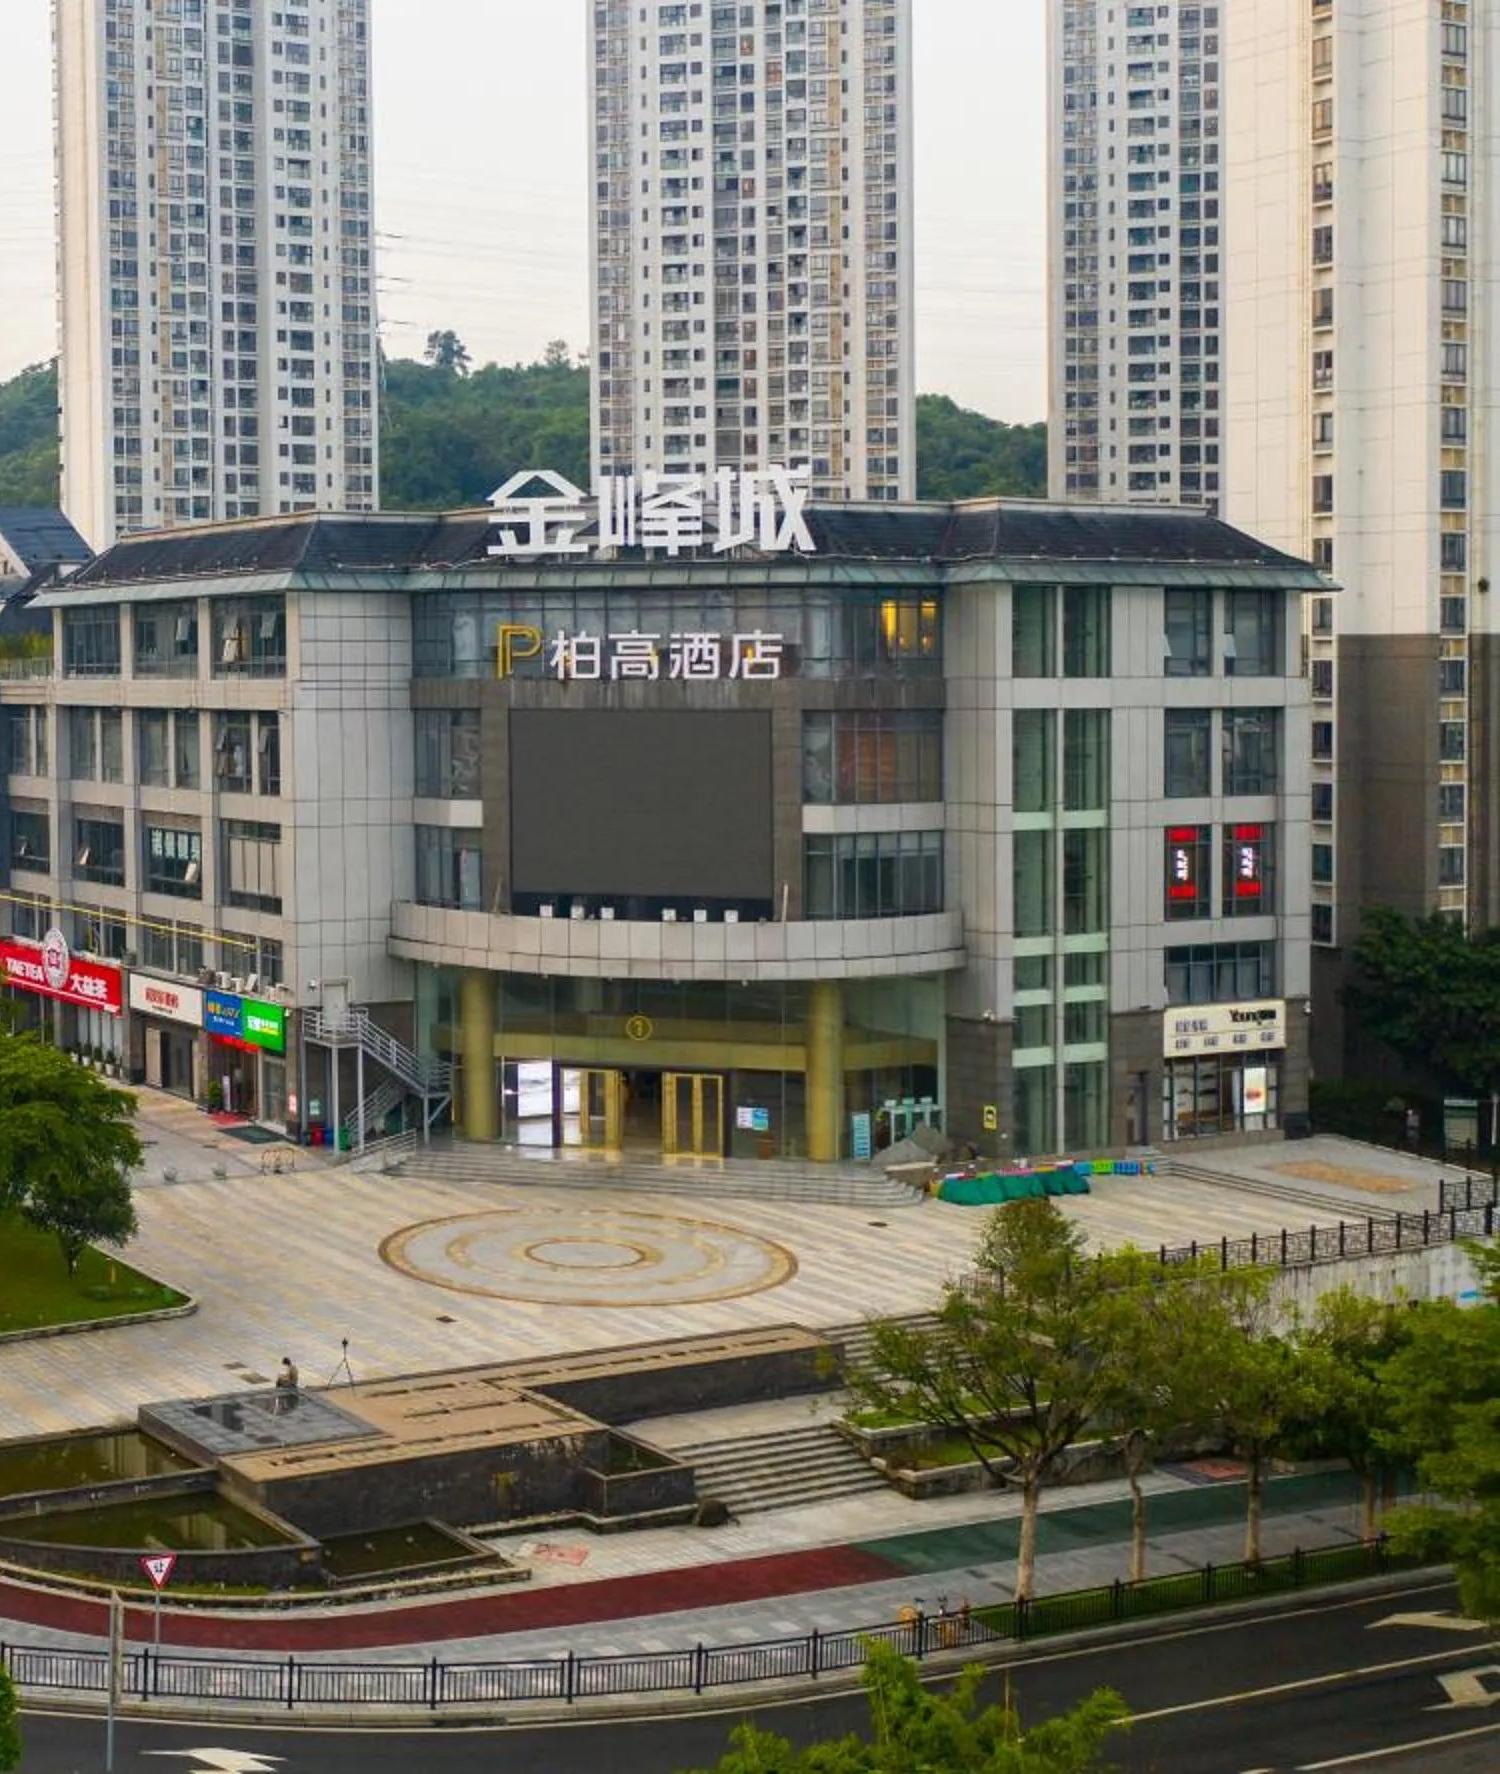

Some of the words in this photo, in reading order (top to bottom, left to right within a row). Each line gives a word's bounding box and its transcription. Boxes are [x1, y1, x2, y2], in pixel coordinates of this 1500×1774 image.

[487, 465, 817, 556] 金峰城
[496, 624, 542, 679] P
[550, 630, 783, 680] 柏高酒店
